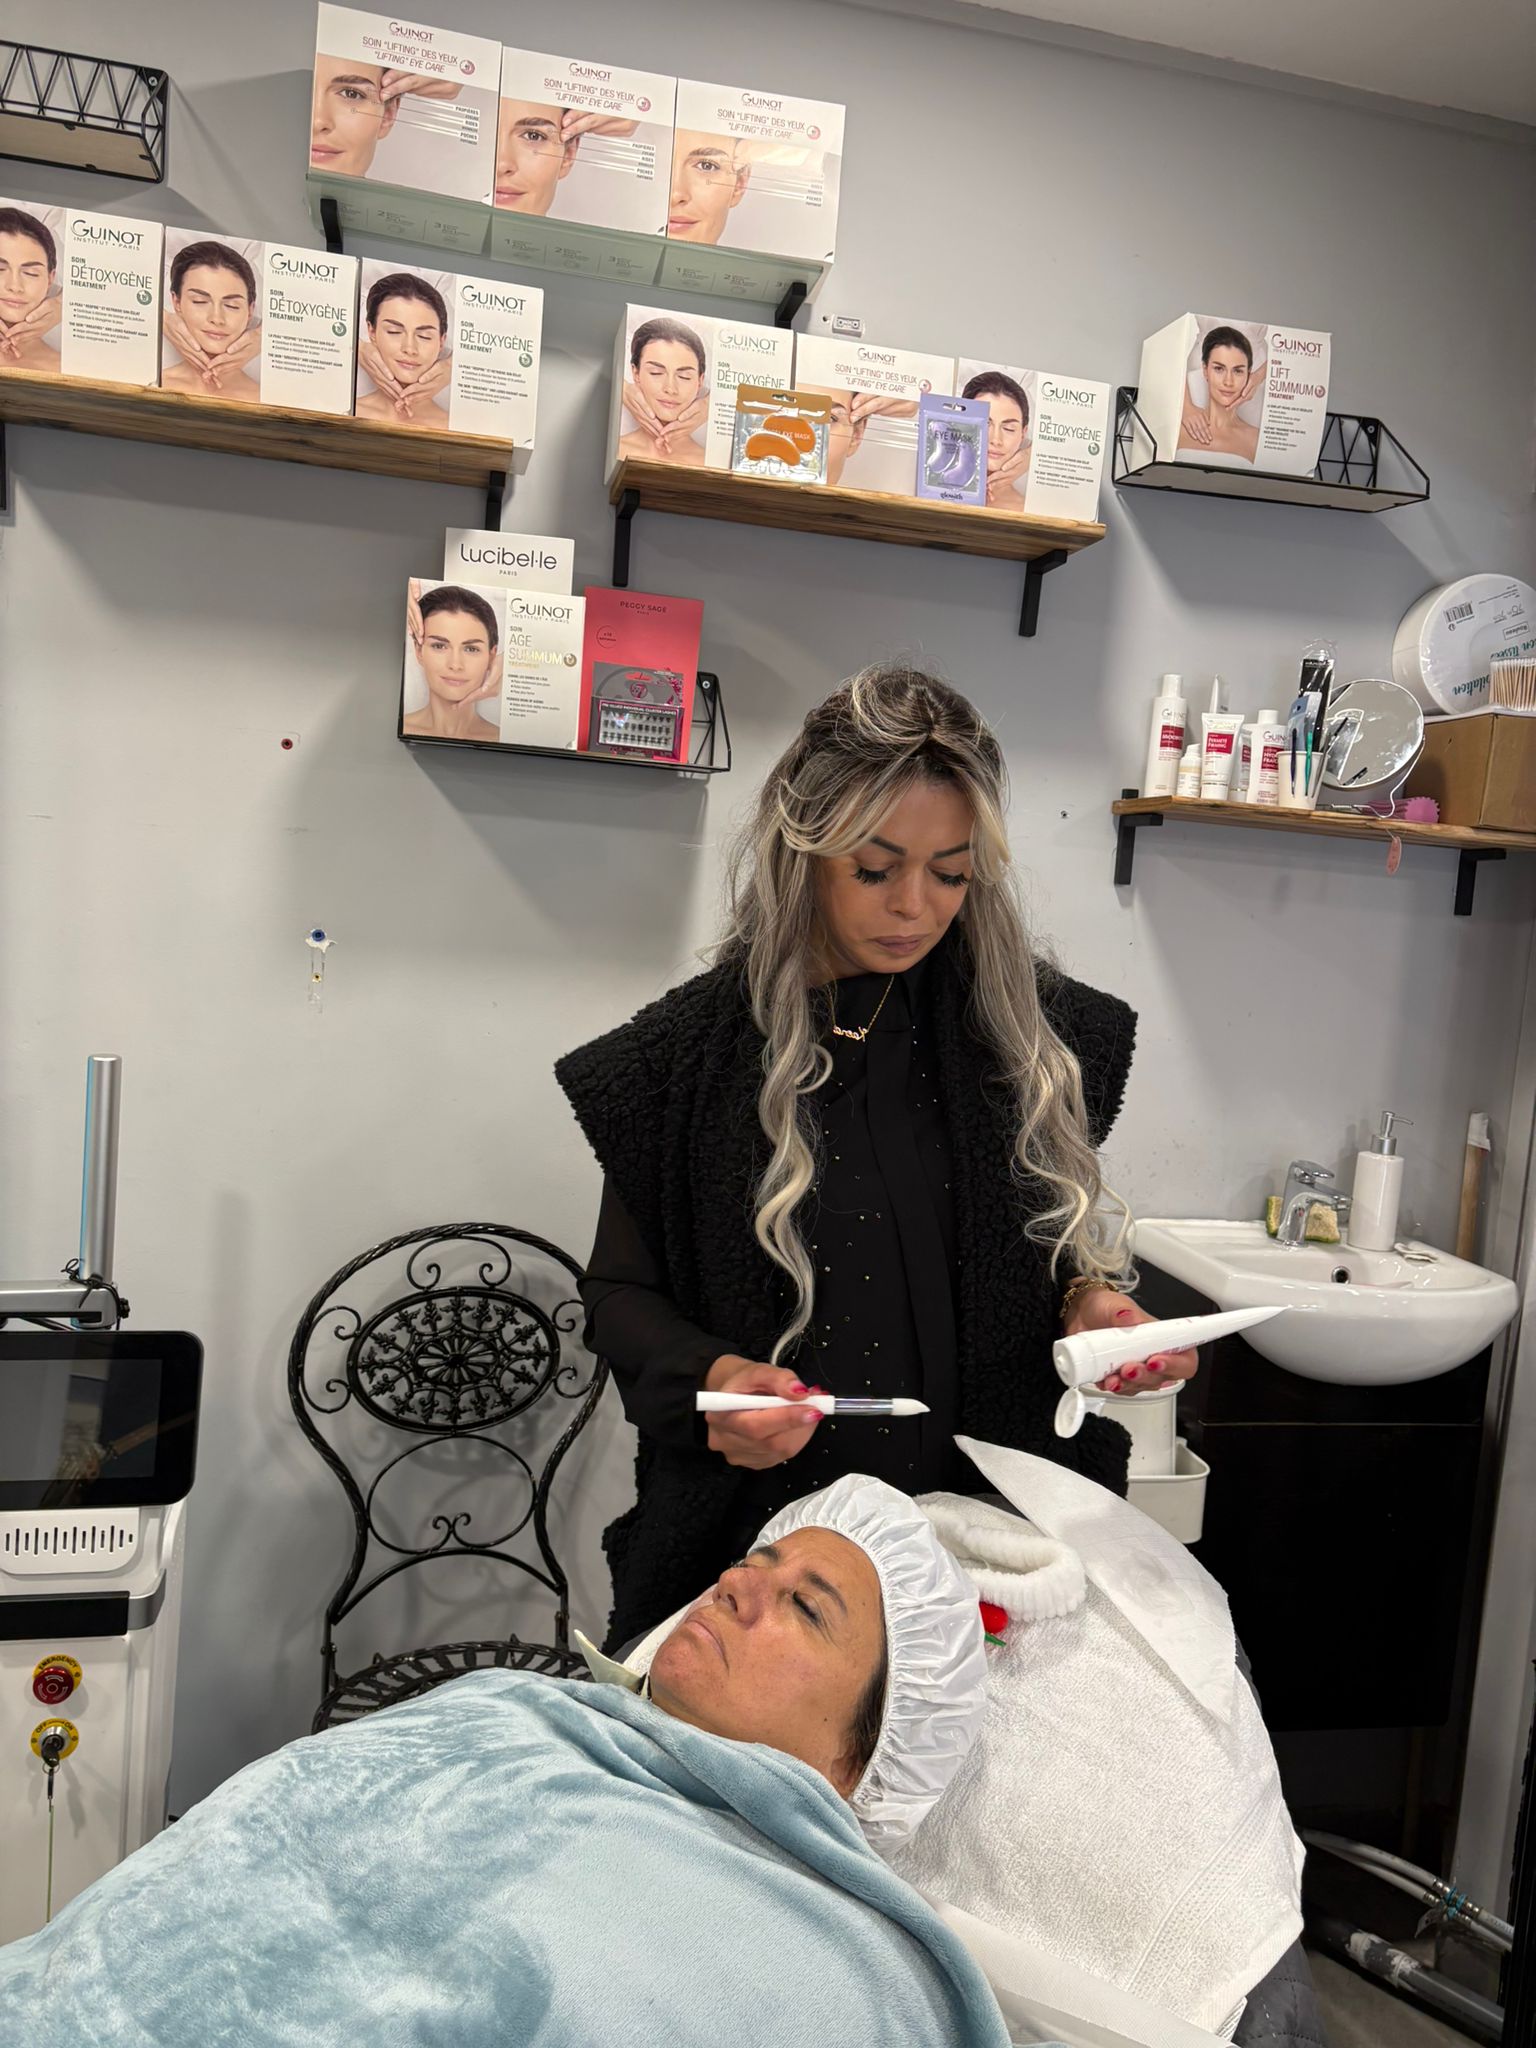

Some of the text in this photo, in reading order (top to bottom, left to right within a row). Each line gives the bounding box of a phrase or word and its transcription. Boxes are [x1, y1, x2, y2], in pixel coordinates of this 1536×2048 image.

[389, 22, 434, 40] GUINOT
[362, 36, 381, 48] SOIN
[384, 41, 419, 55] "LIFTING"
[421, 48, 437, 59] DES
[438, 52, 458, 64] YEUX
[375, 51, 445, 73] "LIFTING" EYE CARE
[569, 62, 612, 80] GUINOT
[544, 78, 562, 88] SOIN
[564, 82, 598, 95] "LIFTING"
[600, 88, 615, 98] DES
[616, 91, 635, 102] YEUX
[555, 92, 623, 111] "LIFTING" EYE CARE
[741, 93, 783, 109] GUINOT
[717, 108, 735, 119] SOIN
[737, 112, 769, 124] "LIFTING"
[771, 118, 786, 127] DES
[787, 121, 805, 131] YEUX
[71, 219, 144, 246] GUINOT
[73, 236, 108, 246] INSTITUT
[71, 256, 86, 264] SOIN
[269, 253, 339, 278] GUINOT
[272, 269, 305, 279] INSTITUT
[70, 280, 107, 291] TREATMENT
[460, 285, 526, 310] GUINOT
[463, 301, 494, 310] INSTITUT
[269, 312, 304, 322] TREATMENT
[719, 329, 779, 351] GUINOT
[720, 343, 749, 351] INSTITUT
[1271, 333, 1323, 354] GUINOT
[460, 343, 492, 353] TREATMENT
[857, 348, 896, 363] GUINOT
[835, 364, 917, 384] SOIN "LIFTING" DES YEUX
[1270, 366, 1291, 379] LIFT
[1041, 381, 1096, 404] GUINOT
[1269, 379, 1314, 396] SUMMUM
[1268, 392, 1294, 400] TREATMENT
[934, 430, 948, 441] EYE
[1039, 434, 1066, 443] TREATMENT
[510, 598, 573, 619] GUINOT
[620, 600, 667, 613] PEGGY SAGE
[509, 633, 532, 647] AGE
[38, 1655, 79, 1670] EMERGENCY
[35, 1721, 75, 1733] OFF ON
